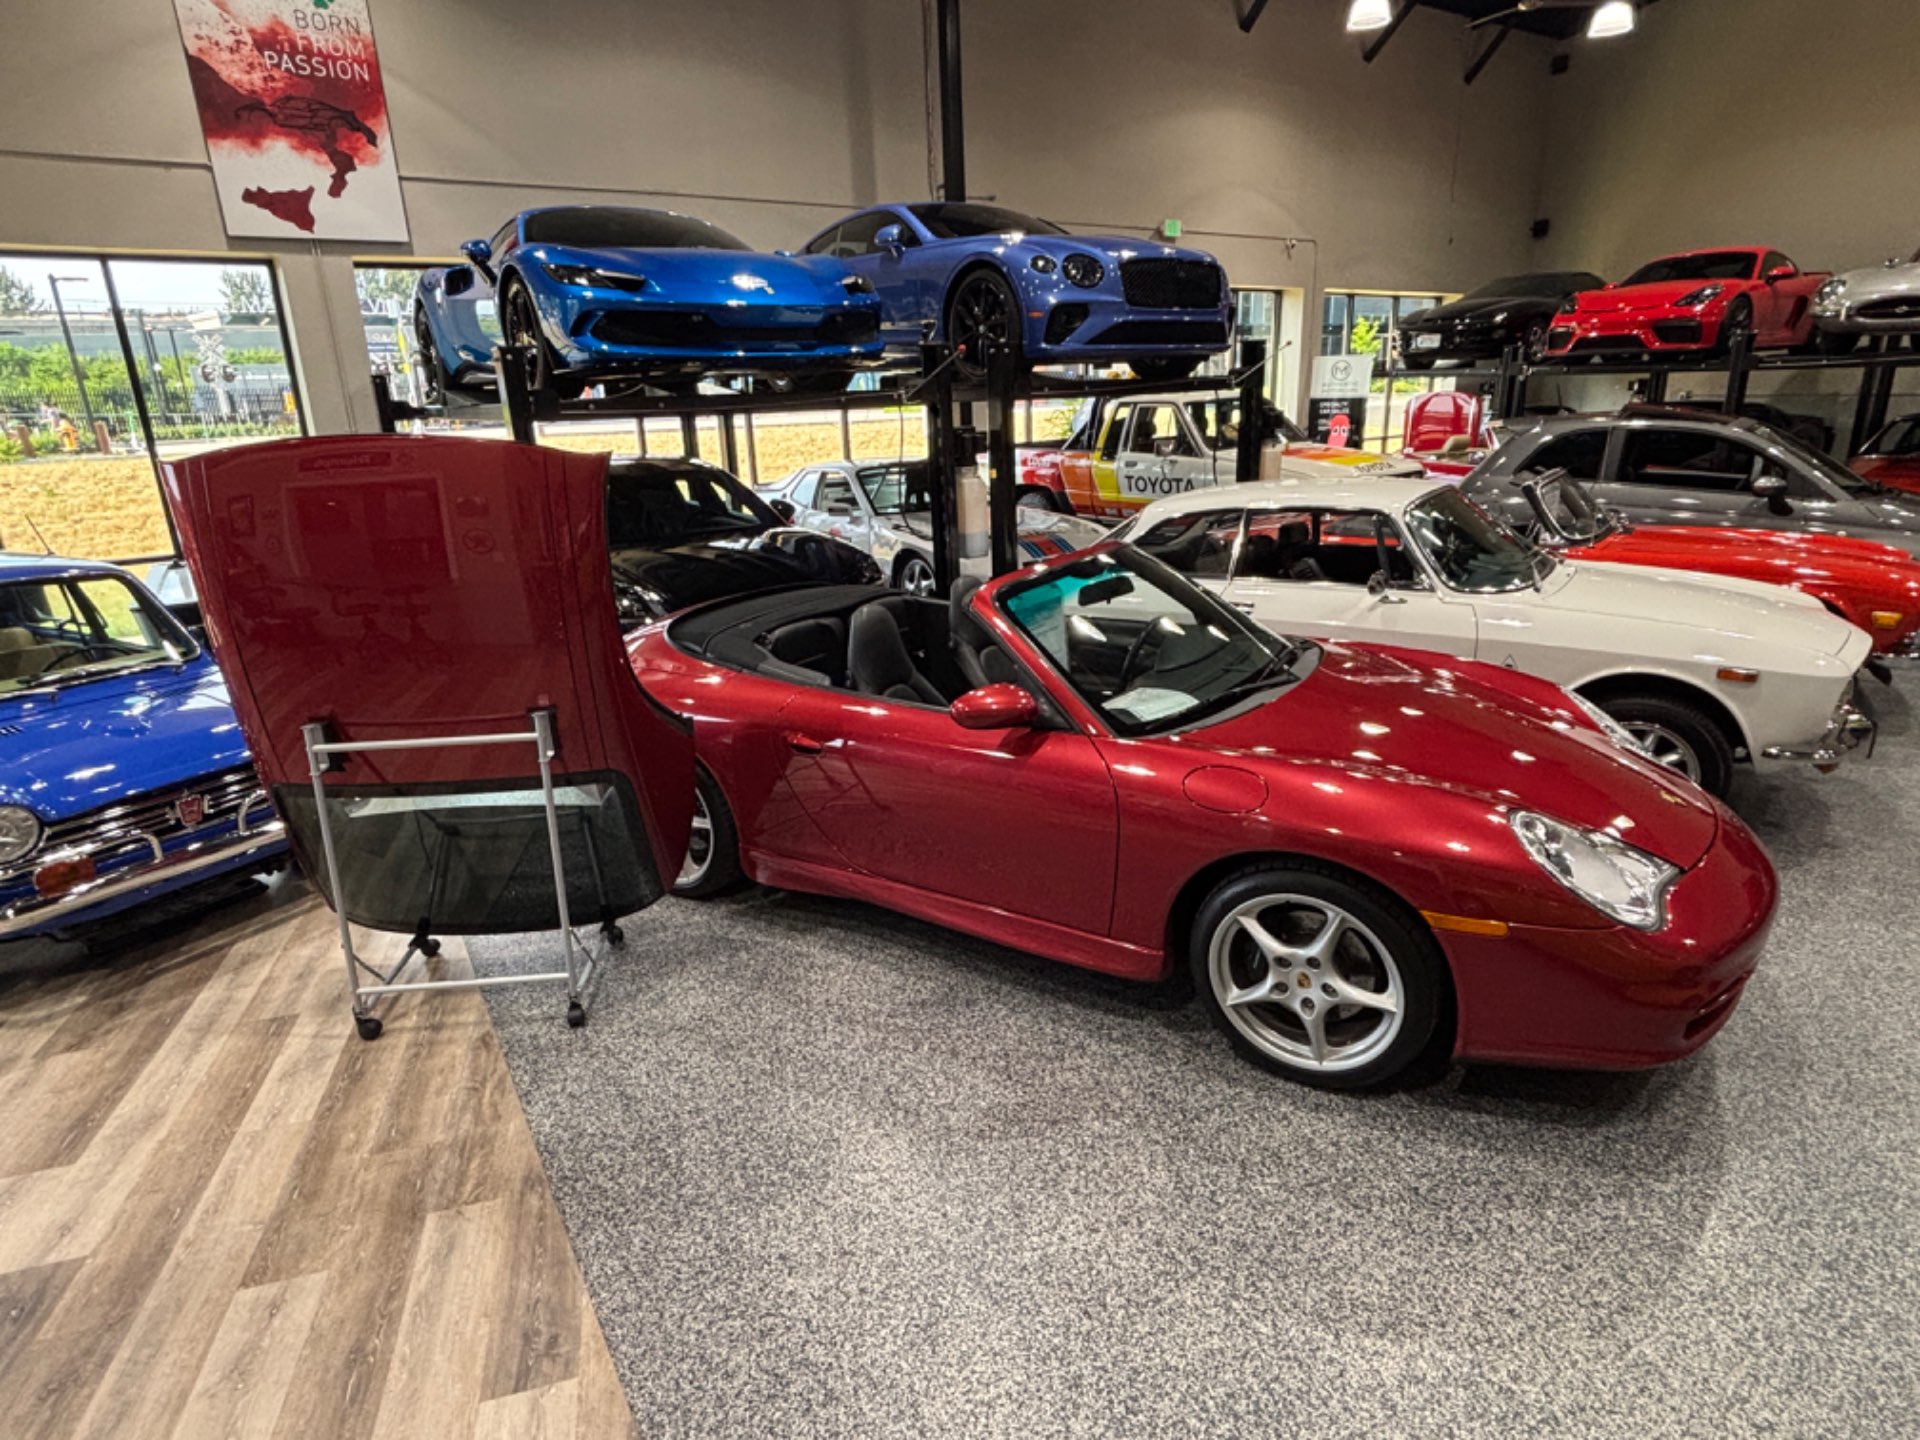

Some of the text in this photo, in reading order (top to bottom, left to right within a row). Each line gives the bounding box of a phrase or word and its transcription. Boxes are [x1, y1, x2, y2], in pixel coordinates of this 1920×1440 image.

[293, 9, 361, 36] BORN
[296, 33, 367, 59] FROM
[263, 50, 371, 82] PASSION
[1124, 475, 1195, 494] TOYOTA
